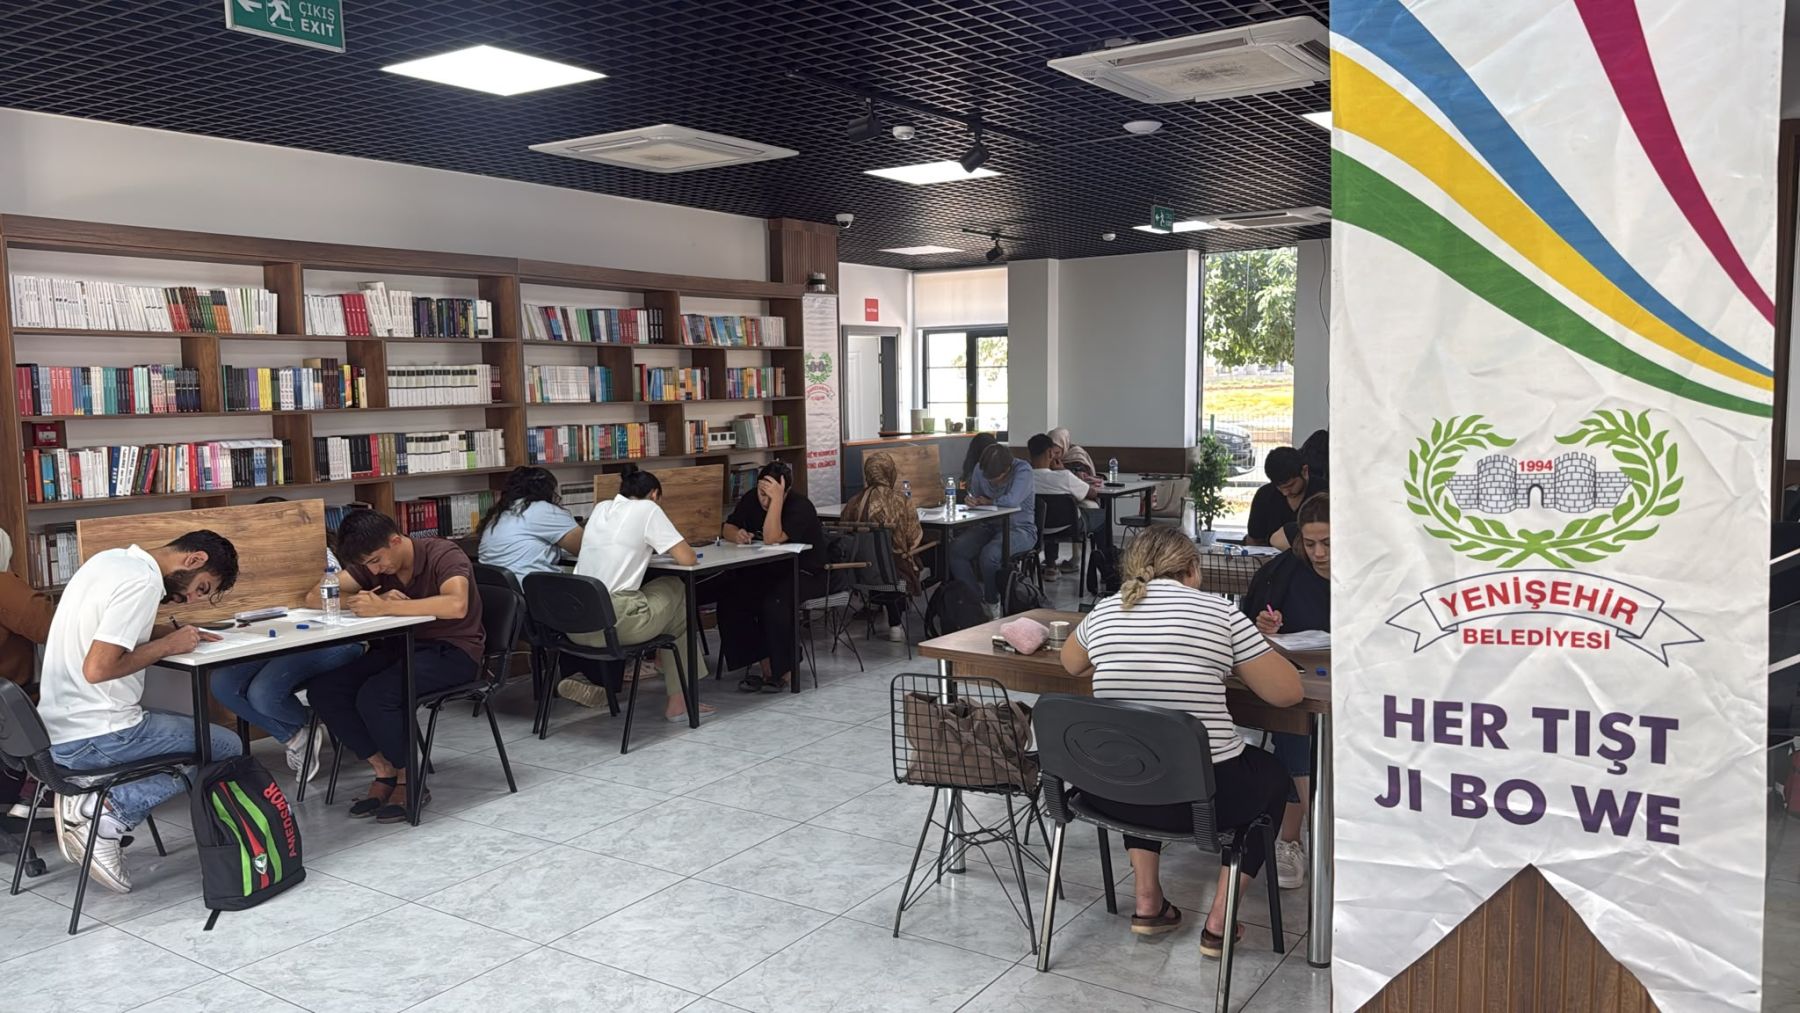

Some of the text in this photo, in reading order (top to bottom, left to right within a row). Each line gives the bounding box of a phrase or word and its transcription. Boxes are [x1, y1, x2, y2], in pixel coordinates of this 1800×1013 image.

[299, 2, 335, 24] ÇIKIŞ
[301, 18, 334, 37] EXIT
[1519, 460, 1553, 473] 1994
[1439, 576, 1640, 625] YENİŞEHİR
[1463, 627, 1610, 650] BELEDİYESİ
[1383, 694, 1679, 775] HER TIŞT
[1374, 765, 1680, 846] JI BO WE
